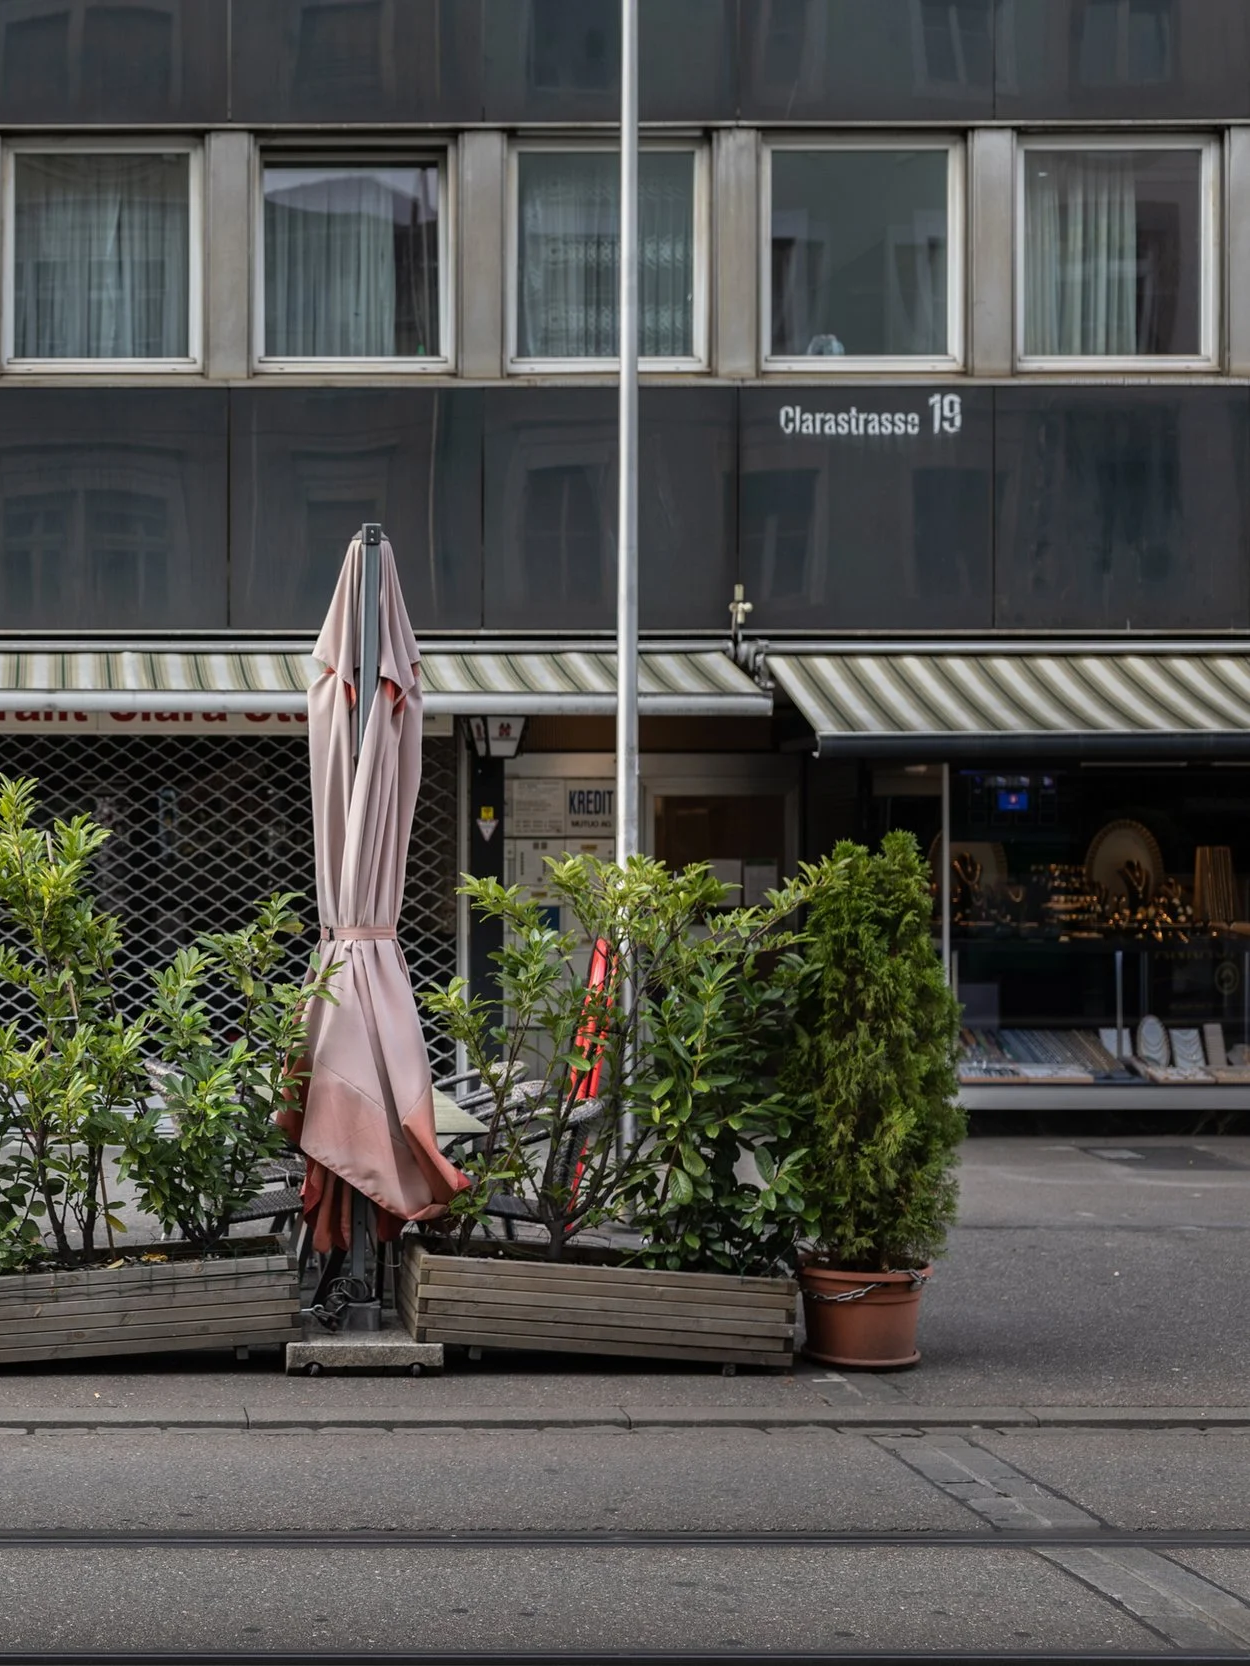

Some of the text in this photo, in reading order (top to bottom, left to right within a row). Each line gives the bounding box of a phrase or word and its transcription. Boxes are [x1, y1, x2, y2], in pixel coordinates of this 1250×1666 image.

[779, 393, 962, 435] Clarastrasse 19
[568, 790, 615, 816] KREDIT
